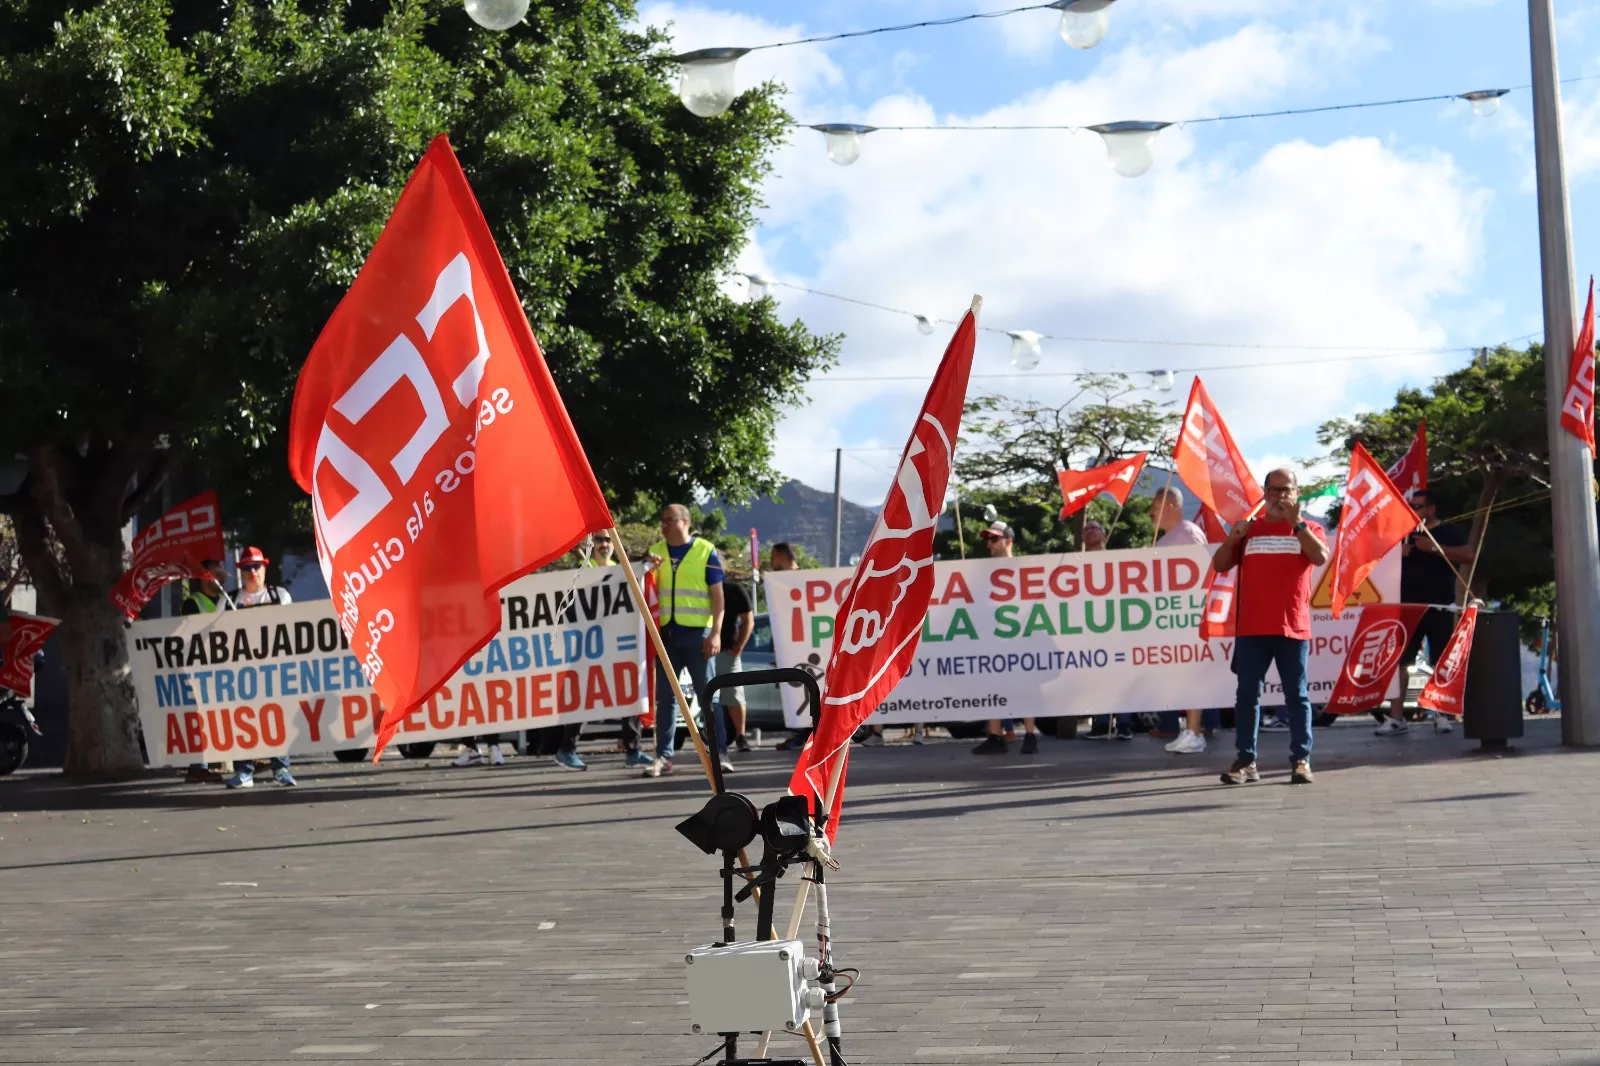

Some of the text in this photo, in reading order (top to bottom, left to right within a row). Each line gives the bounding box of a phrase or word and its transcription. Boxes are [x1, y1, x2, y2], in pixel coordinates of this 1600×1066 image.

[989, 557, 1211, 602] SEGURID
[135, 617, 350, 670] "TRABAJADO
[500, 574, 634, 632] RANVÍA
[922, 608, 979, 642] LA
[994, 598, 1152, 639] SALUD
[1155, 595, 1182, 611] DE
[1155, 613, 1203, 631] CIUD
[1313, 613, 1335, 622] Polv
[154, 655, 372, 708] METROTENER
[918, 657, 931, 677] Y
[937, 649, 1109, 676] METROPOLITANO
[1132, 642, 1214, 667] DESIDIA
[1219, 642, 1233, 661] Y
[166, 702, 286, 755] ABUSO
[299, 698, 326, 743] Y
[875, 693, 1008, 715] gaMetroTenerife
